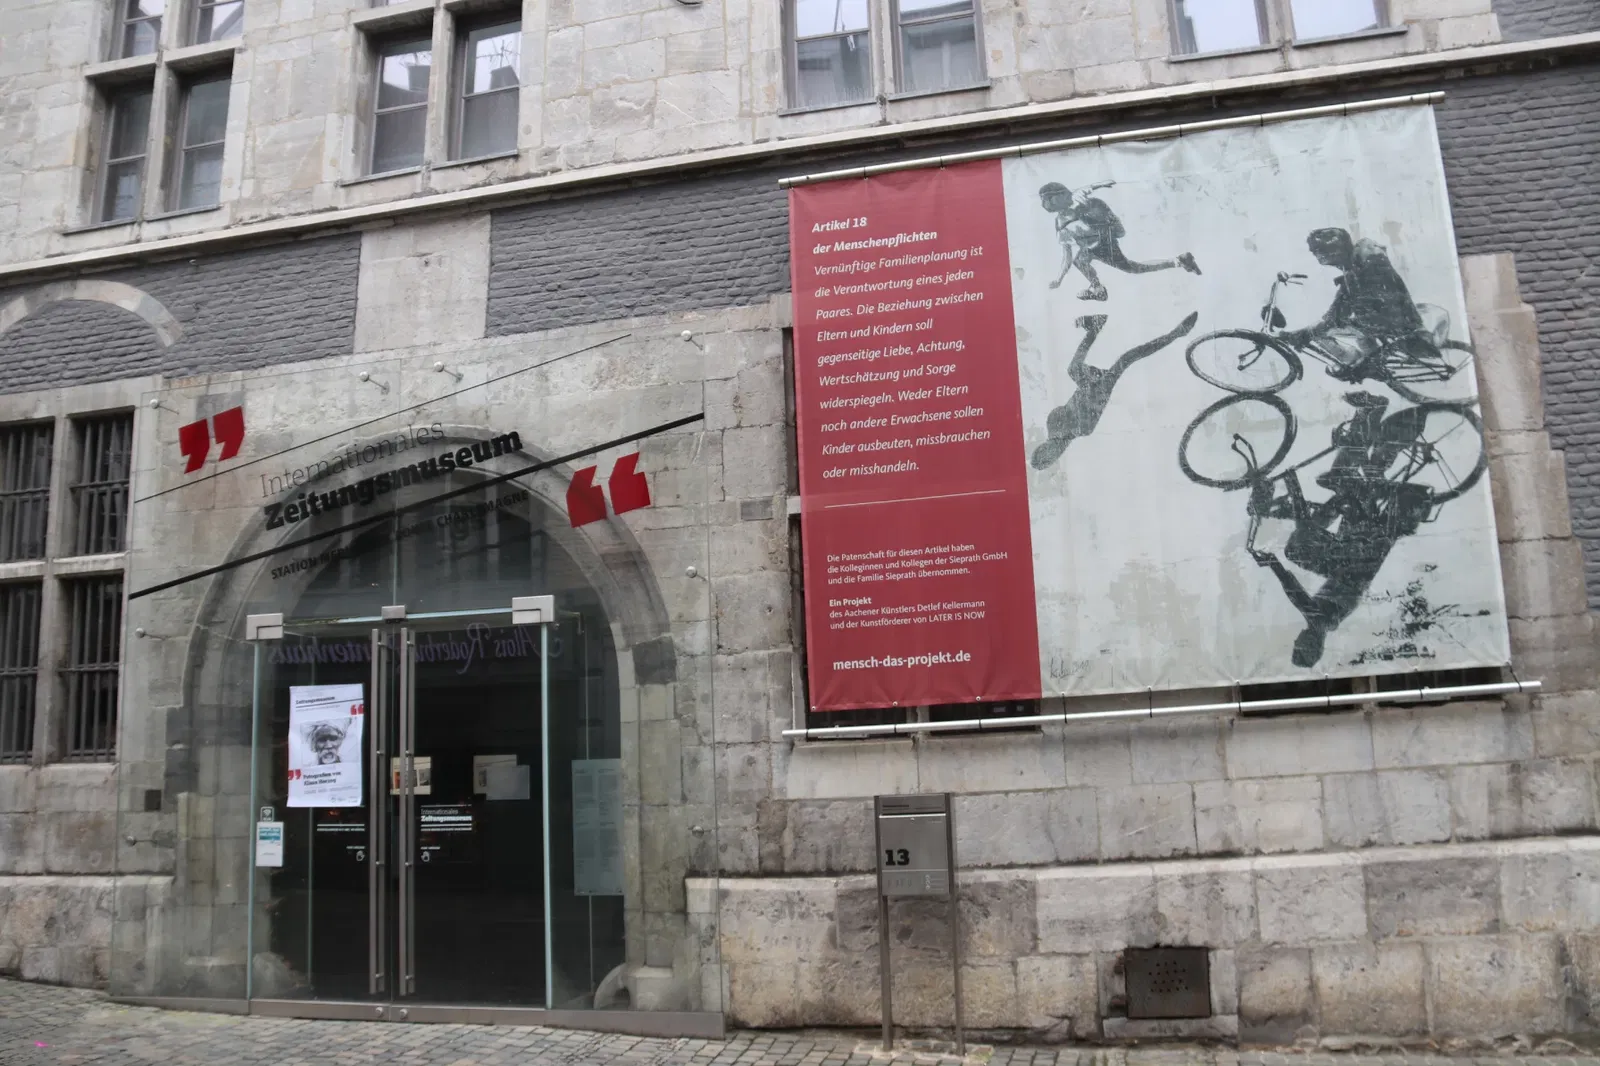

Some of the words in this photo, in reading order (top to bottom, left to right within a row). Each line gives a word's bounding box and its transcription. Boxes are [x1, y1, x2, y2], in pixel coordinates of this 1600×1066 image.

[811, 218, 850, 233] Artikel
[852, 216, 868, 228] 18
[812, 243, 832, 255] der
[833, 231, 938, 252] Menschenpflichten
[814, 260, 877, 276] Vernünftige
[878, 249, 968, 268] Familienplanung
[970, 246, 983, 257] ist
[814, 286, 831, 298] die
[833, 278, 914, 295] Verantwortung
[915, 274, 943, 286] eines
[943, 269, 974, 285] jeden
[816, 308, 853, 320] Paares.
[856, 303, 875, 315] Die
[877, 298, 933, 313] Beziehung
[934, 291, 984, 306] zwischen
[817, 330, 848, 342] Eltern
[849, 325, 871, 338] und
[873, 322, 913, 336] Kindern
[914, 318, 933, 331] soll
[817, 348, 881, 368] gegenseitige
[883, 344, 914, 358] Liebe,
[916, 339, 965, 354] Achtung,
[819, 370, 900, 387] Wertschätzung
[902, 364, 924, 378] und
[925, 363, 957, 376] Sorge
[819, 392, 895, 409] widerspiegeln.
[898, 388, 933, 402] Weder
[935, 385, 969, 398] Eltern
[820, 419, 847, 433] noch
[849, 416, 888, 430] andere
[890, 411, 952, 426] Erwachsene
[953, 405, 984, 419] sollen
[822, 442, 856, 456] Kinder
[857, 438, 914, 452] ausbeuten,
[915, 429, 991, 446] missbrauchen
[260, 421, 446, 498] Internationales
[822, 466, 847, 479] oder
[849, 459, 920, 476] misshandeln.
[263, 430, 523, 531] Zeitungsmuseum
[827, 554, 840, 563] Die
[841, 550, 885, 561] Patenschaft
[886, 549, 897, 558] für
[898, 548, 923, 557] diesen
[924, 544, 950, 554] Artikel
[951, 543, 975, 552] haben
[827, 565, 839, 574] die
[839, 563, 884, 573] Kolleginnen
[885, 560, 900, 569] und
[901, 559, 934, 568] Kollegen
[934, 557, 948, 565] der
[949, 553, 981, 565] Sieprath
[981, 551, 1008, 561] GmbH
[271, 557, 318, 580] STATION
[828, 576, 843, 585] und
[843, 575, 856, 584] die
[857, 572, 884, 583] Familie
[885, 570, 917, 581] Sieprath
[918, 567, 970, 578] übernommen.
[829, 599, 842, 607] Ein
[842, 596, 872, 607] Projekt
[829, 610, 843, 619] des
[844, 606, 880, 617] Aachener
[881, 605, 916, 615] Künstlers
[917, 601, 941, 612] Detlef
[942, 600, 985, 610] Kellermann
[830, 620, 845, 630] und
[845, 620, 859, 629] der
[860, 617, 912, 627] Kunstförderer
[912, 616, 927, 624] von
[928, 613, 953, 623] LATER
[954, 612, 962, 620] IS
[963, 610, 986, 620] NOW
[833, 649, 972, 671] mensch-das-projekt.de
[885, 848, 910, 866] 13
